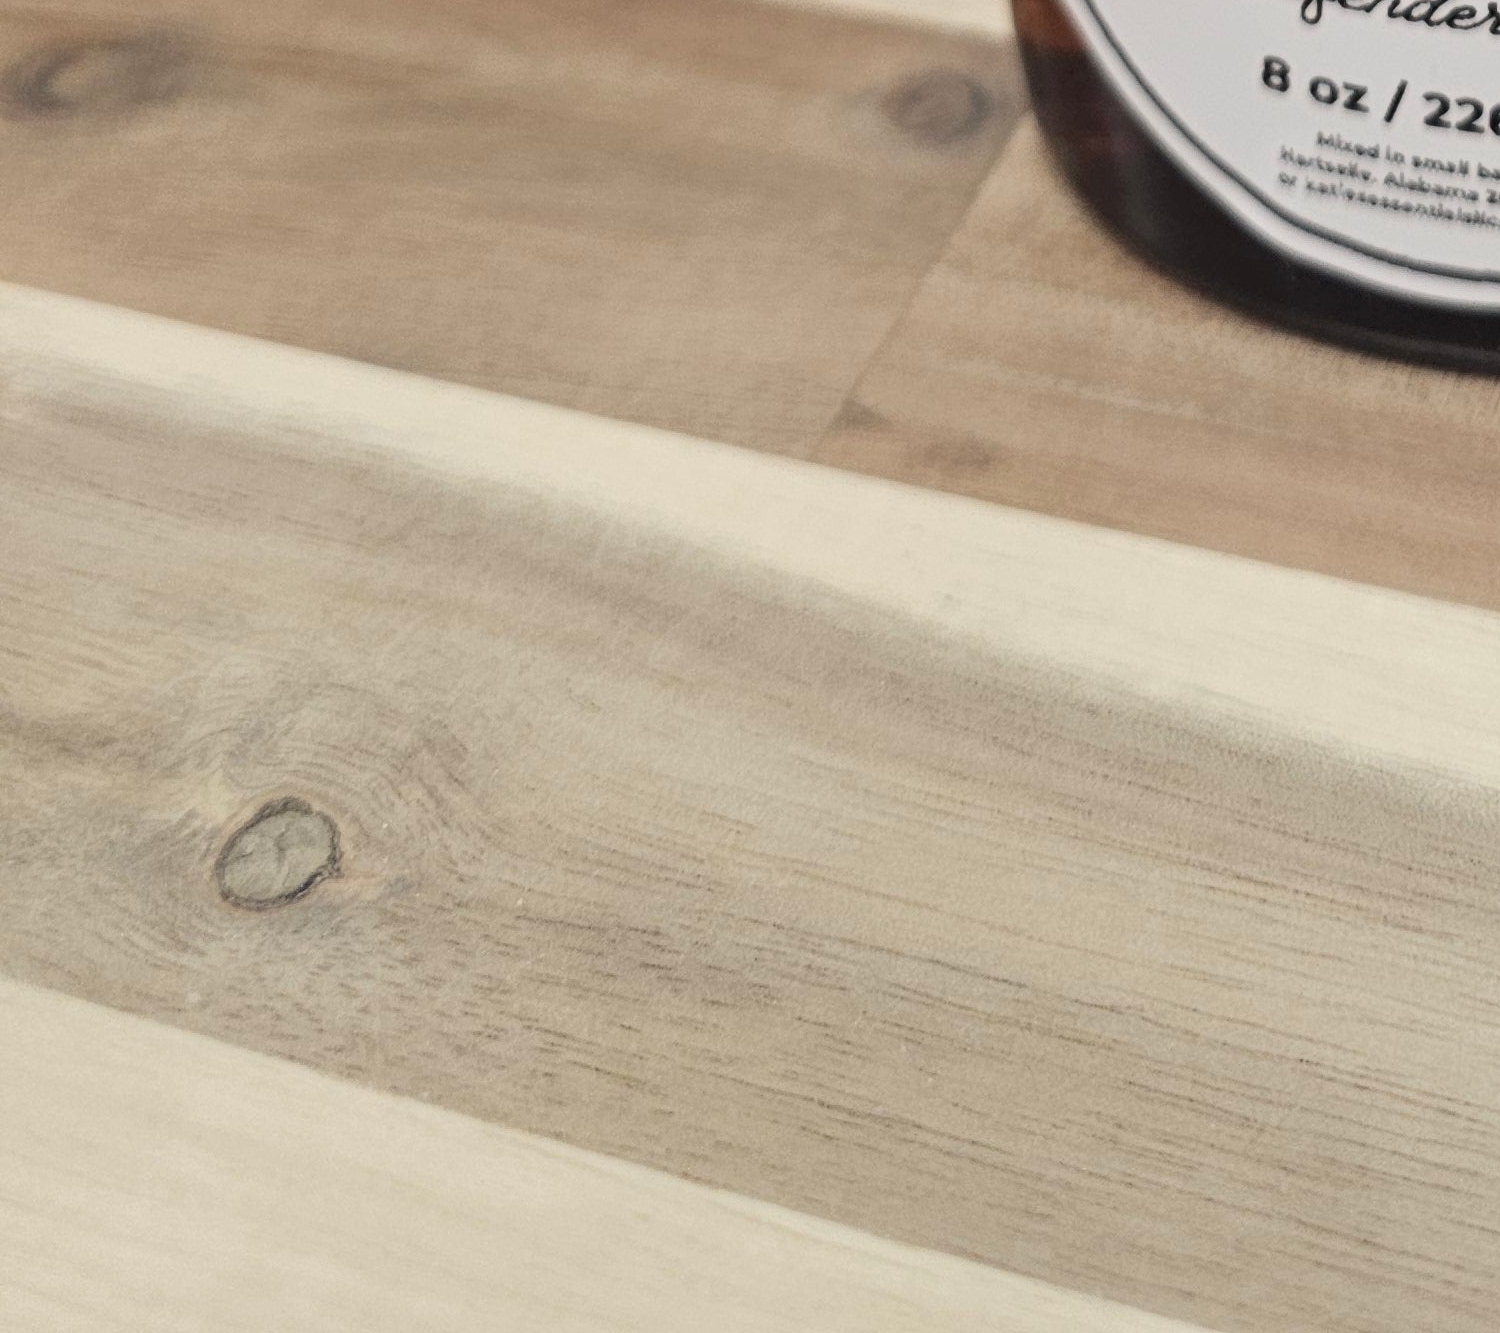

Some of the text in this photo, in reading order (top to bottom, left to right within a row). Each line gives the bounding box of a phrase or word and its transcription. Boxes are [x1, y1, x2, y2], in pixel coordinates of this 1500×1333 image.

[1261, 54, 1291, 94] 8
[1308, 74, 1370, 115] oz
[1383, 78, 1408, 123] /
[1316, 130, 1381, 160] Mixed
[1386, 144, 1406, 167] in
[1411, 154, 1470, 177] small
[1279, 172, 1297, 187] or
[1384, 171, 1480, 203] Alabama
